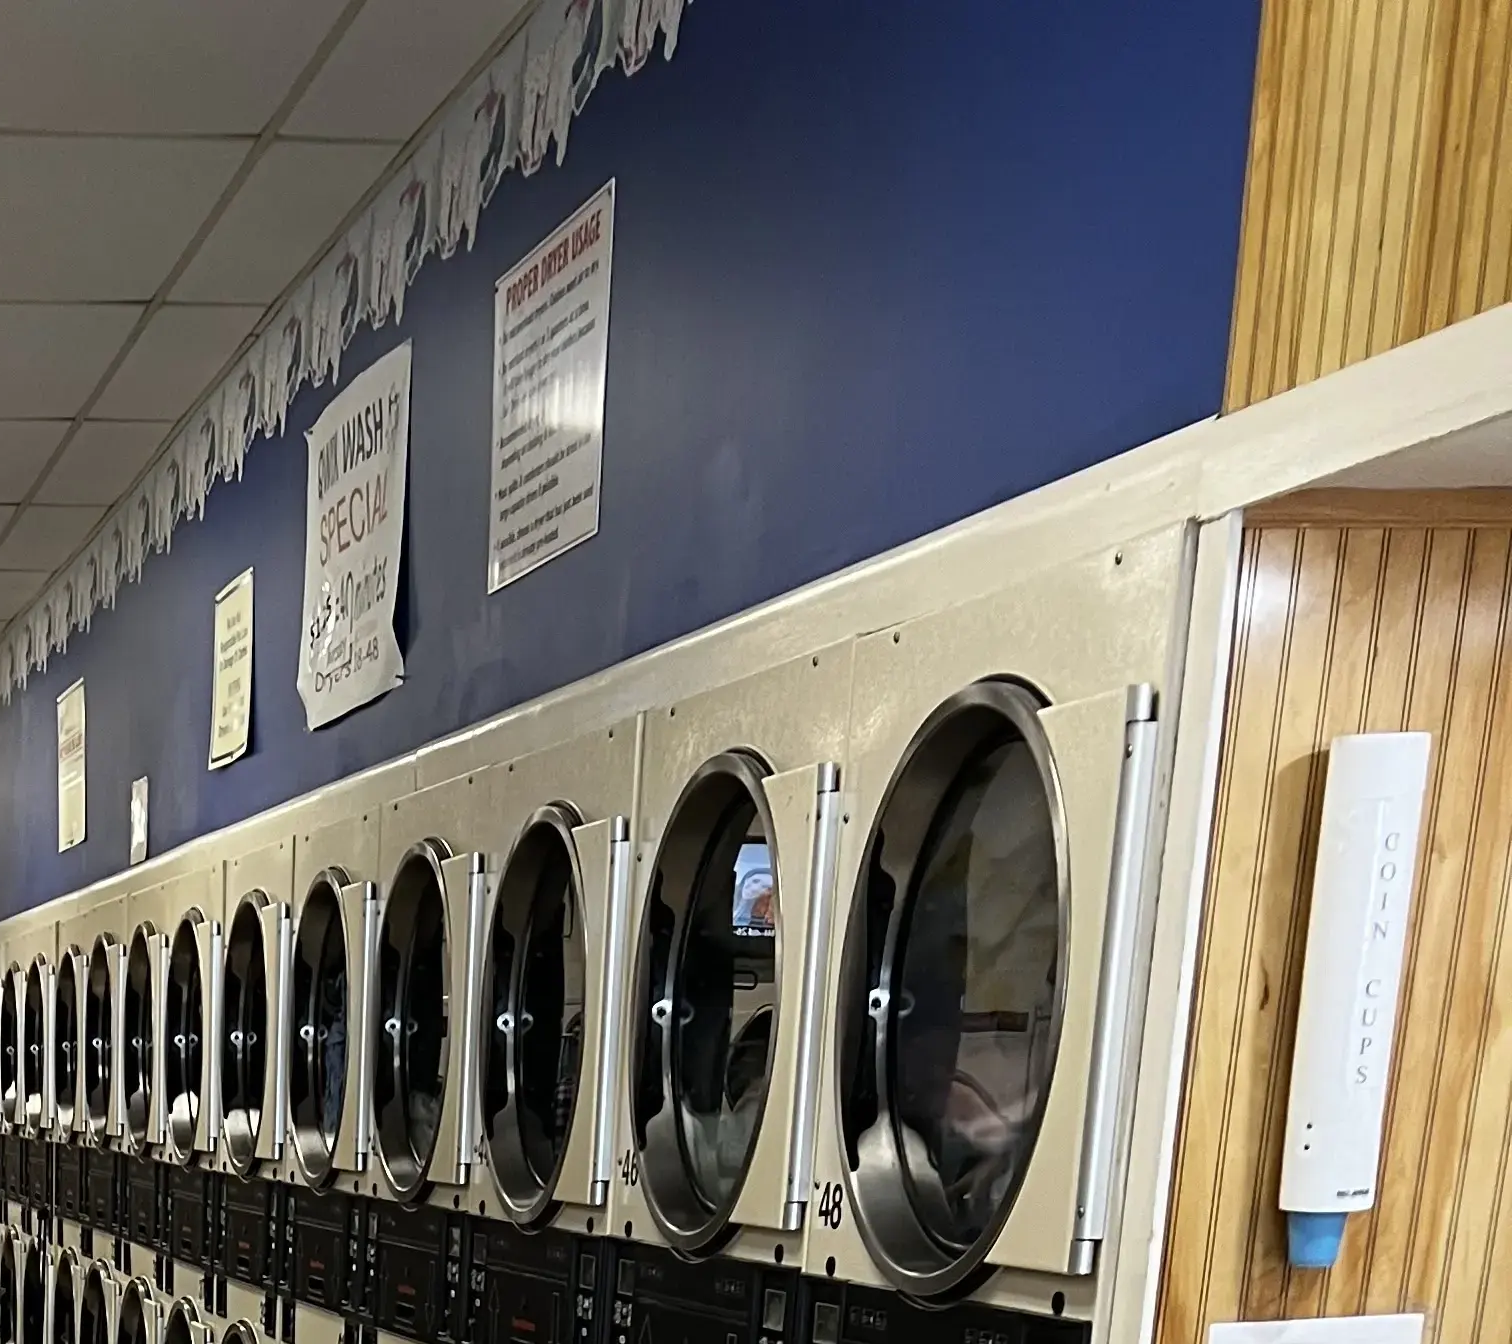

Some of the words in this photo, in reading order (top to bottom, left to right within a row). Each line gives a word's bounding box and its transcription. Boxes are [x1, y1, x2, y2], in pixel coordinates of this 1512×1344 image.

[506, 264, 539, 316] PROPER
[540, 240, 569, 287] DRYER
[571, 209, 602, 260] USAGE
[342, 397, 383, 474] WASH
[320, 468, 388, 567] SPECIAL
[1372, 832, 1401, 940] COIN
[1355, 979, 1382, 1084] CUPS
[622, 1149, 638, 1186] 46
[818, 1181, 843, 1229] 48
